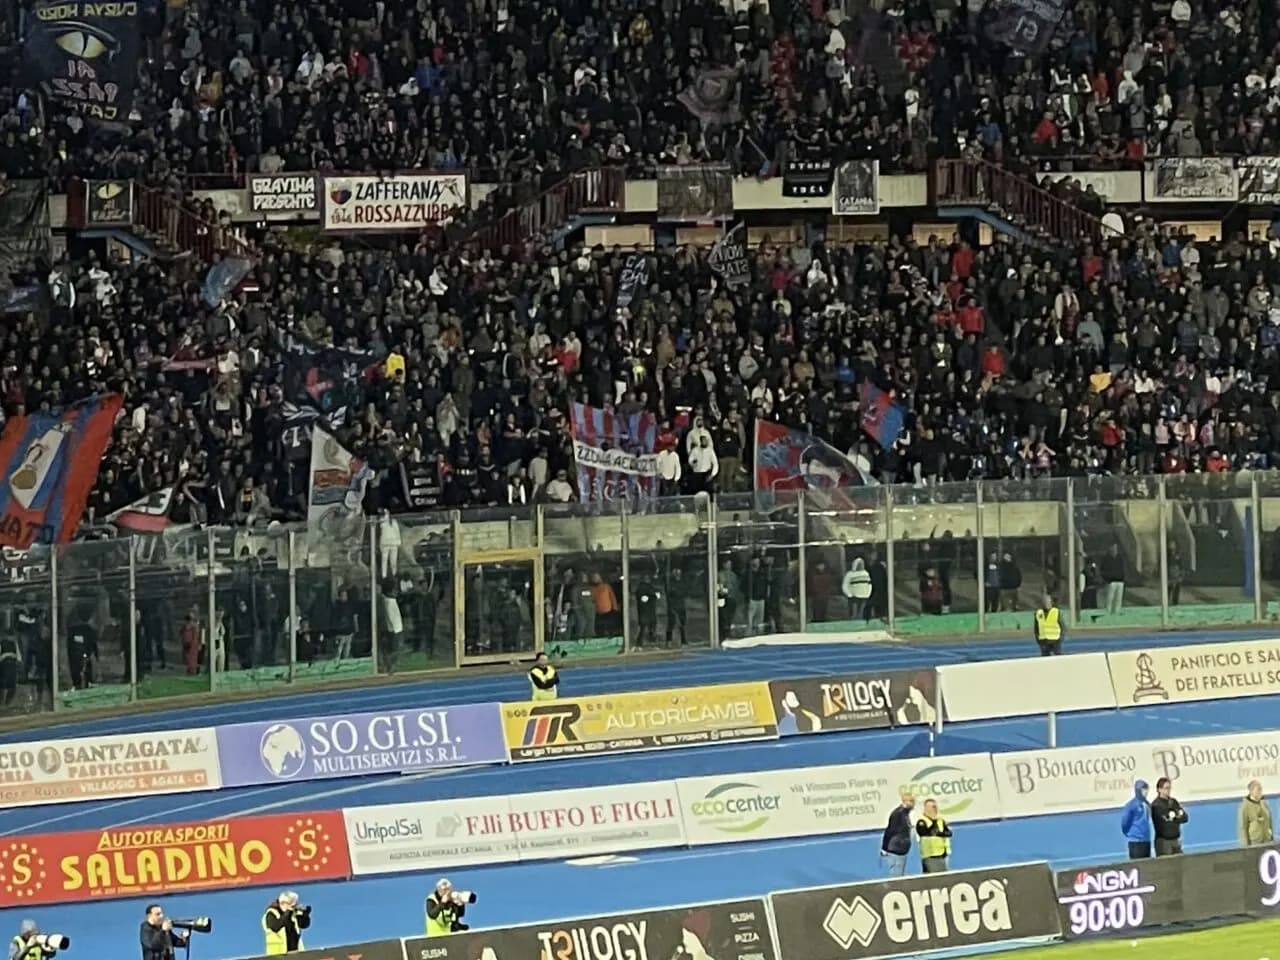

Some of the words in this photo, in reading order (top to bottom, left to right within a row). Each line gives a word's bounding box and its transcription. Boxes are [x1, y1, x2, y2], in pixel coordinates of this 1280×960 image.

[355, 179, 441, 201] ZAFFERANA
[354, 203, 452, 224] ROSSAZZURR
[1171, 652, 1241, 671] PANIFICIO
[1245, 651, 1253, 665] E
[1176, 677, 1198, 692] DEI
[1203, 671, 1263, 690] FRATELLI
[821, 679, 892, 717] TRILOGY
[606, 701, 755, 730] AUTORICAMBI
[310, 711, 462, 757] SO.GI.SI.
[63, 737, 200, 764] SANT'AGATA
[313, 749, 421, 774] MULTISERVIZI
[1180, 742, 1279, 767] Bonaccorso
[69, 759, 170, 778] PASTICCERIA
[1037, 754, 1136, 779] Bonaccorso
[1237, 761, 1278, 779] brand
[80, 776, 136, 793] VILLAGGIO
[151, 774, 185, 788] AGATA
[898, 776, 984, 798] ecocenter
[1094, 776, 1134, 792] brand
[690, 793, 781, 817] ecocenter
[355, 817, 423, 844] UnipolSai
[465, 812, 503, 836] F.lli
[508, 806, 585, 833] BUFFO
[591, 804, 607, 825] E
[612, 798, 675, 823] FIGLI
[98, 823, 229, 849] AUTOTRASPORTI
[61, 839, 272, 891] SALADINO
[730, 911, 756, 923] SUSHI
[1070, 894, 1144, 934] 90:00
[734, 931, 760, 943] PIZZA
[421, 947, 448, 960] SUSHI
